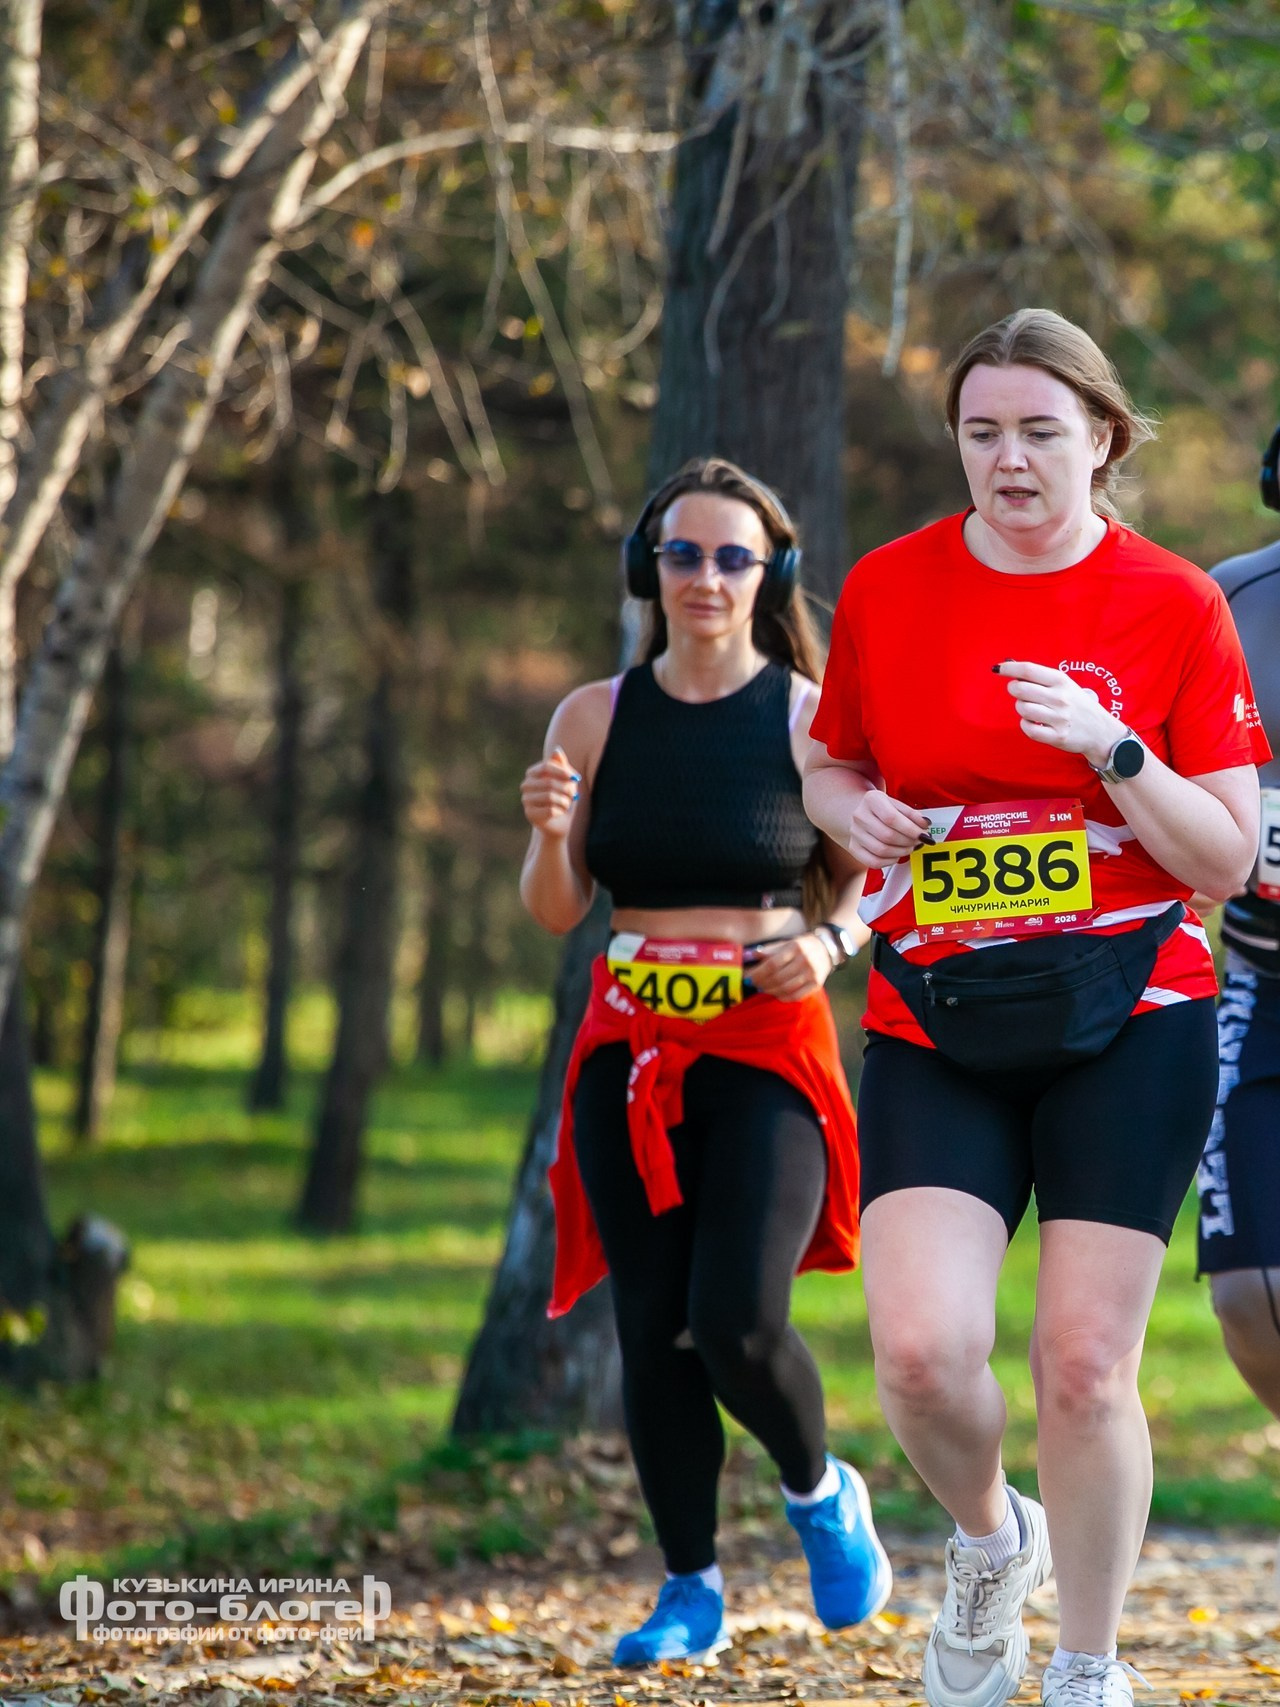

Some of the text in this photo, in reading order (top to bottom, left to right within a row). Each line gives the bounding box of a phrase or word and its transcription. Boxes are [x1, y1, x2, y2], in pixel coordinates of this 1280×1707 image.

[1058, 659, 1122, 696] бщество
[963, 811, 1028, 824] КРАСНОЯРСКИЕ
[1049, 812, 1072, 822] 5 КМ
[981, 819, 1011, 829] МОСТЫ
[927, 827, 946, 835] БЕР
[922, 840, 1080, 903] 5386
[950, 897, 1050, 913] ЧИЧУРИНА МАРИЯ
[1054, 914, 1077, 924] 2026
